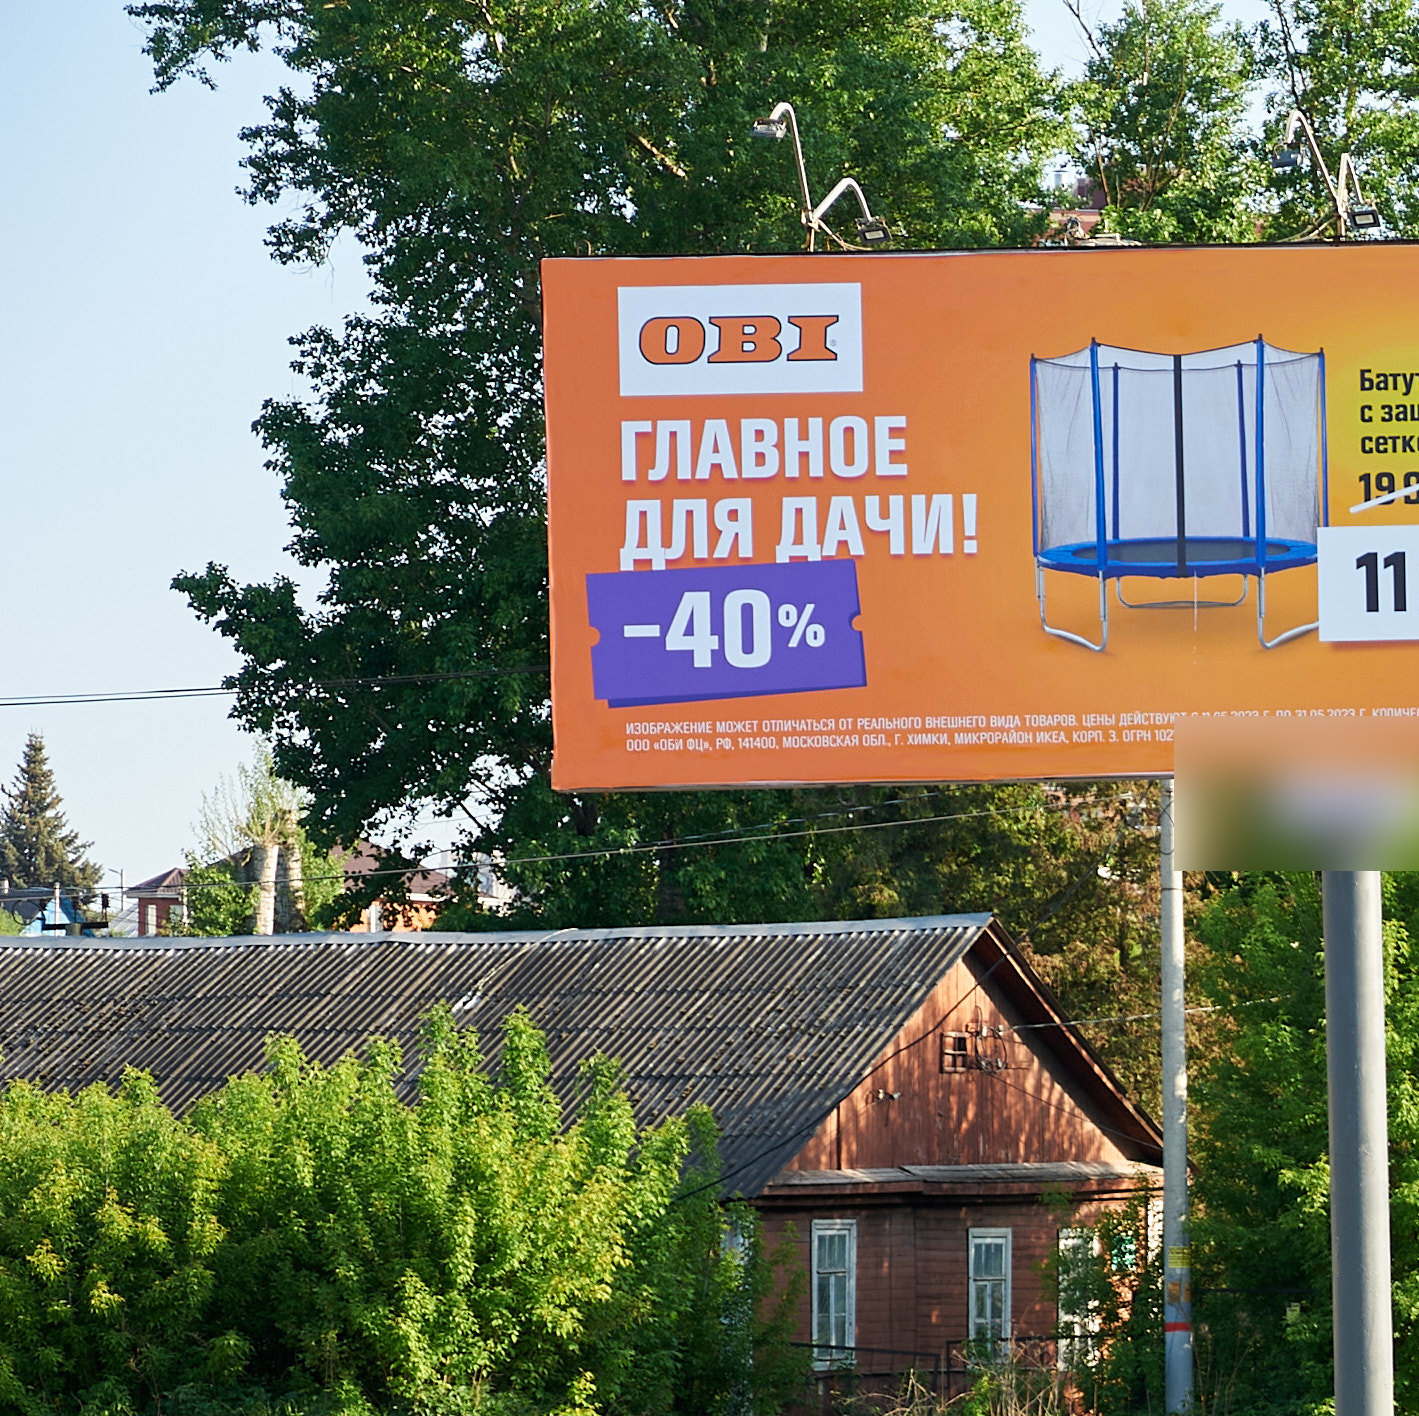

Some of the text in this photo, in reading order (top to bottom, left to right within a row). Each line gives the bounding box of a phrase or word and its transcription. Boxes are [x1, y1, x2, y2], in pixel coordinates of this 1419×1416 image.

[639, 314, 840, 365] OBI
[1360, 404, 1373, 423] с
[620, 415, 908, 481] ГЛАВНОЕ
[619, 493, 978, 571] ДЛЯ ДАЧИ!
[626, 720, 712, 734] ИЗОБРАЖЕНИЕ
[716, 720, 758, 733] МОЖЕТ
[762, 719, 835, 732] ОТЛИЧАТЬСЯ
[839, 718, 853, 730] ОТ
[857, 717, 921, 730] РЕАЛЬНОГО
[925, 715, 986, 729] ВНЕШНЕГО
[990, 714, 1021, 728] ВИДА
[1024, 714, 1079, 727] ТОВАРОВ.
[1082, 713, 1115, 727] ЦЕНЫ
[626, 738, 650, 751] ООО
[783, 734, 859, 748] МОСКОВСКАЯ
[894, 733, 904, 745] Г.
[907, 732, 951, 746] ХИМКИ,
[954, 730, 1033, 744] МИКРОРАЙОН
[1036, 731, 1069, 744] ИКЕА,
[1072, 730, 1105, 743] КОРП.
[1122, 729, 1151, 742] ОГРН
